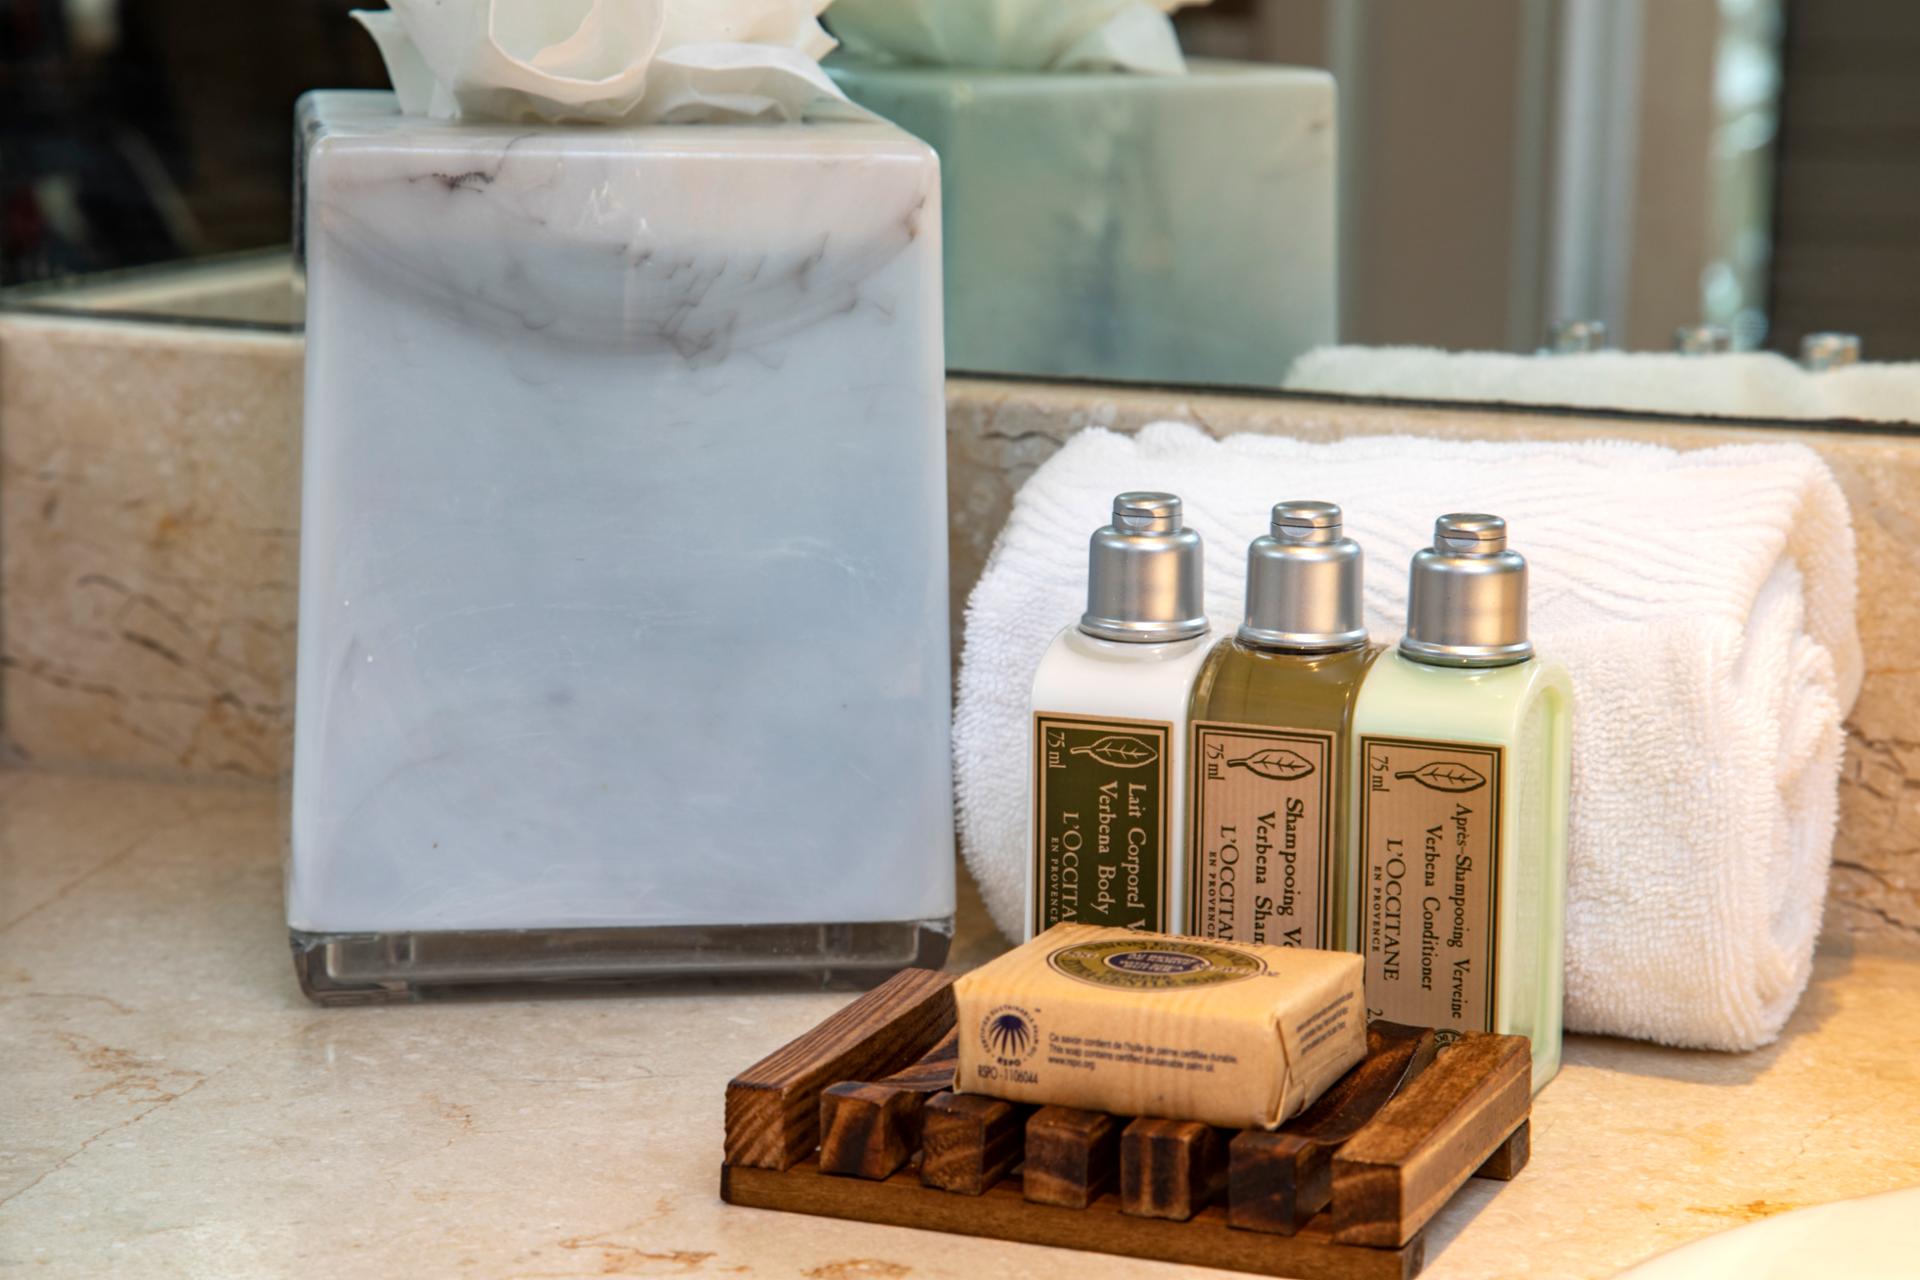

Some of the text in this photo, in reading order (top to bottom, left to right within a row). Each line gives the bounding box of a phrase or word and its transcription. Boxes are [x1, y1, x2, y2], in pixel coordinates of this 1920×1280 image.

[1048, 732, 1066, 768] 75 ml
[1207, 744, 1225, 780] 75 ml
[1372, 756, 1390, 792] 75 ml
[1128, 782, 1147, 818] Lait
[1050, 837, 1059, 922] EN PROVENCE
[1062, 812, 1082, 923] L'OCCITA
[1090, 780, 1118, 915] Verbena Body
[1121, 828, 1146, 909] Corporel
[1256, 811, 1276, 884] Verbena
[1276, 797, 1304, 916] Shampooing
[1207, 852, 1217, 940] EN PROVENCE
[1372, 866, 1382, 952] EN PROVENCE
[1384, 838, 1406, 981] L'OCCITANE
[1421, 824, 1443, 992] Verbena Conditioner
[1446, 803, 1473, 1019] Après-Shampooing Verveine
